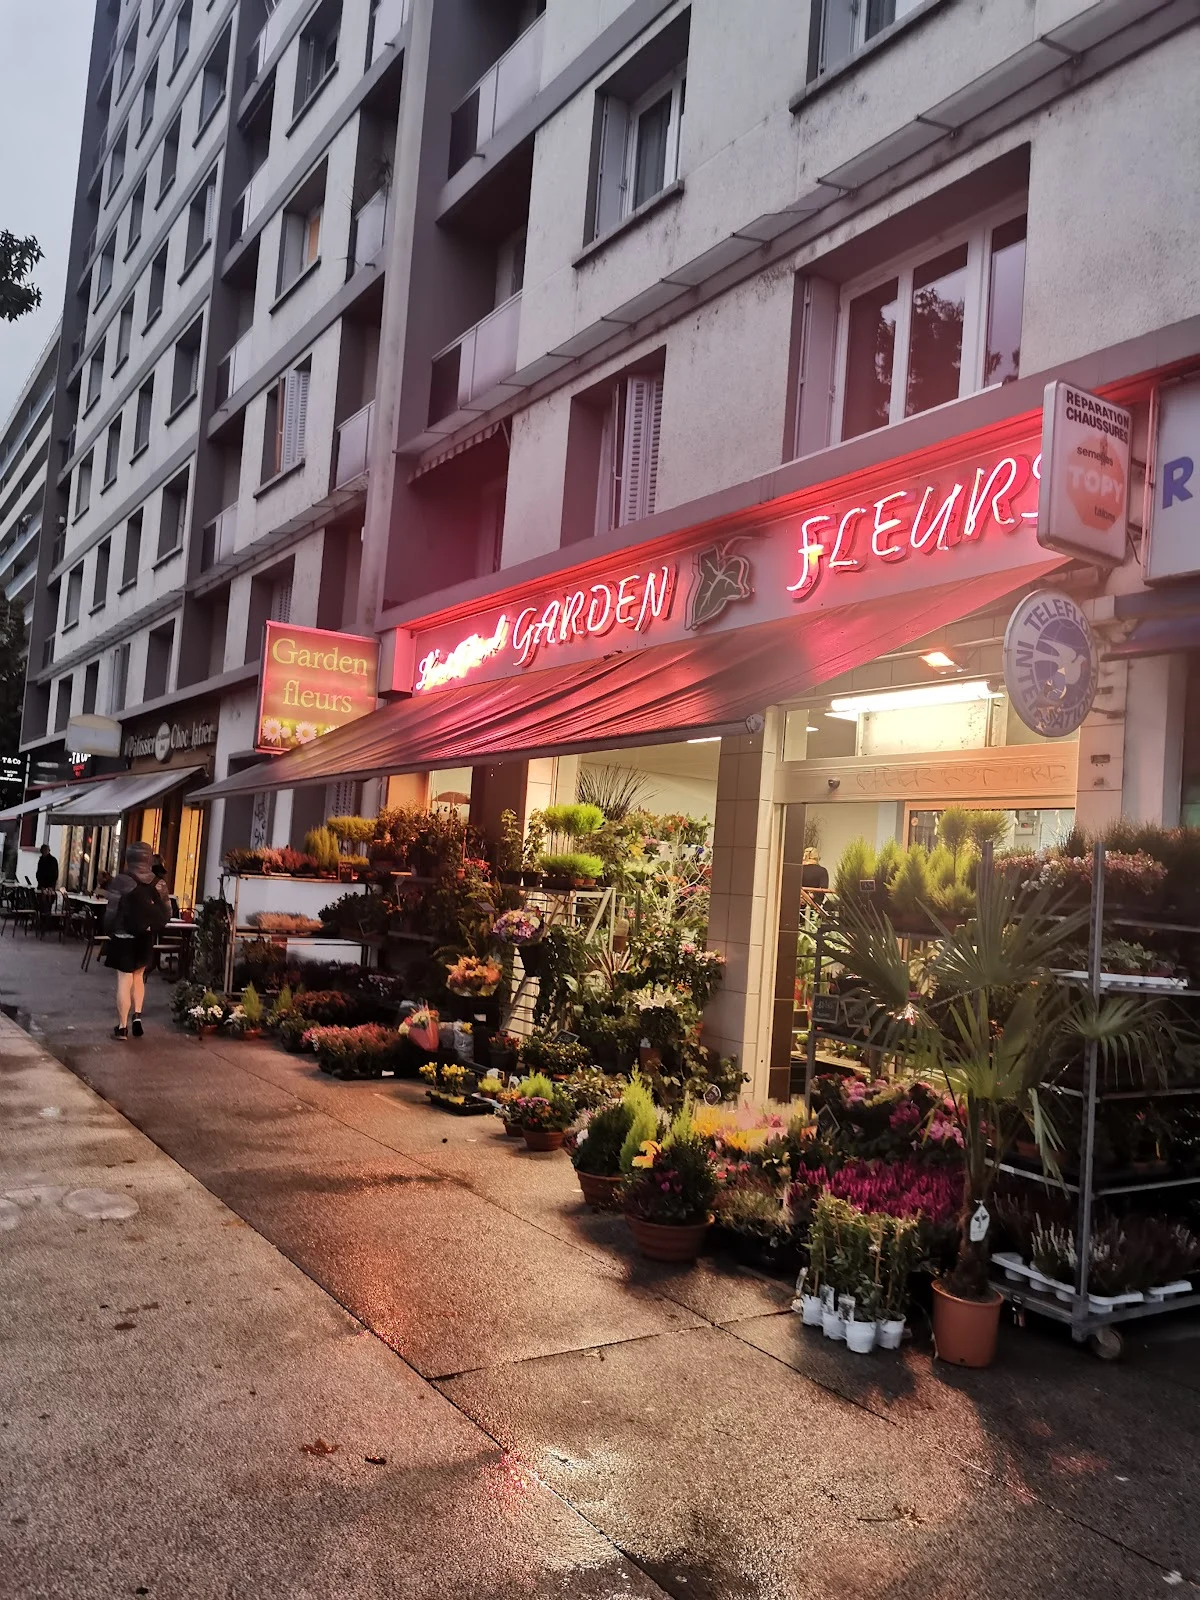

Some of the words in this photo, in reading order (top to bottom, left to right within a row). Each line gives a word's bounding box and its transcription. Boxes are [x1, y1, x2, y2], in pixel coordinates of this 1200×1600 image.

[1066, 390, 1130, 430] RÉPARATION
[1066, 407, 1128, 445] CHAUSSURES
[1068, 466, 1123, 503] TOPY
[513, 564, 675, 668] GARDEN
[272, 638, 369, 676] Garden
[282, 679, 353, 713] fleurs
